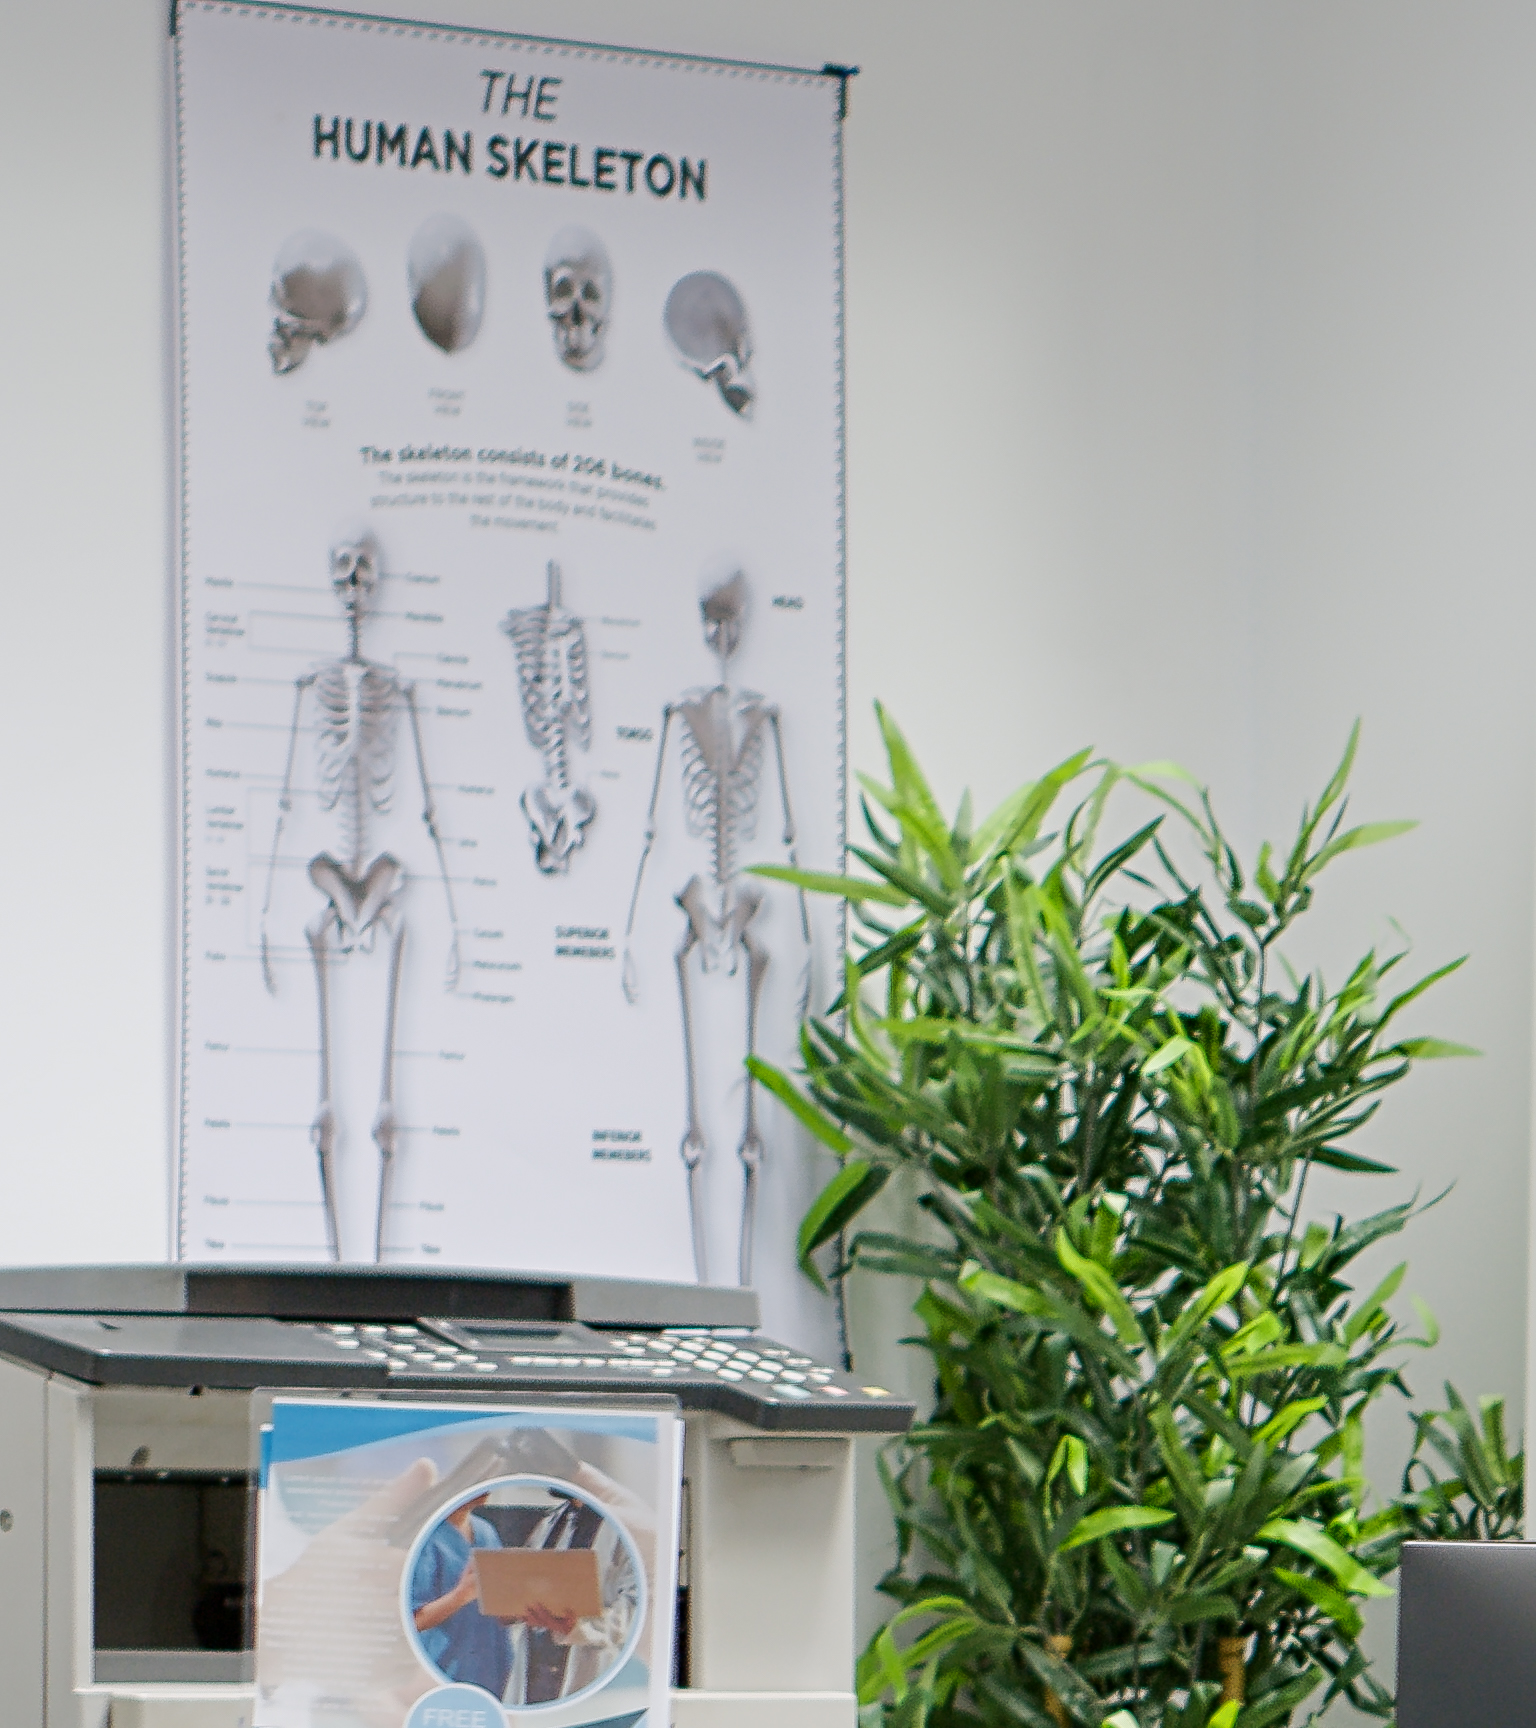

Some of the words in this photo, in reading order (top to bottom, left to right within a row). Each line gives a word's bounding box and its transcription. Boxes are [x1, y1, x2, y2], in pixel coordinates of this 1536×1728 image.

[480, 69, 564, 121] THE
[313, 113, 473, 175] HUMAN
[486, 134, 707, 202] SKELETON
[551, 452, 569, 470] of
[423, 1707, 487, 1728] FREE
